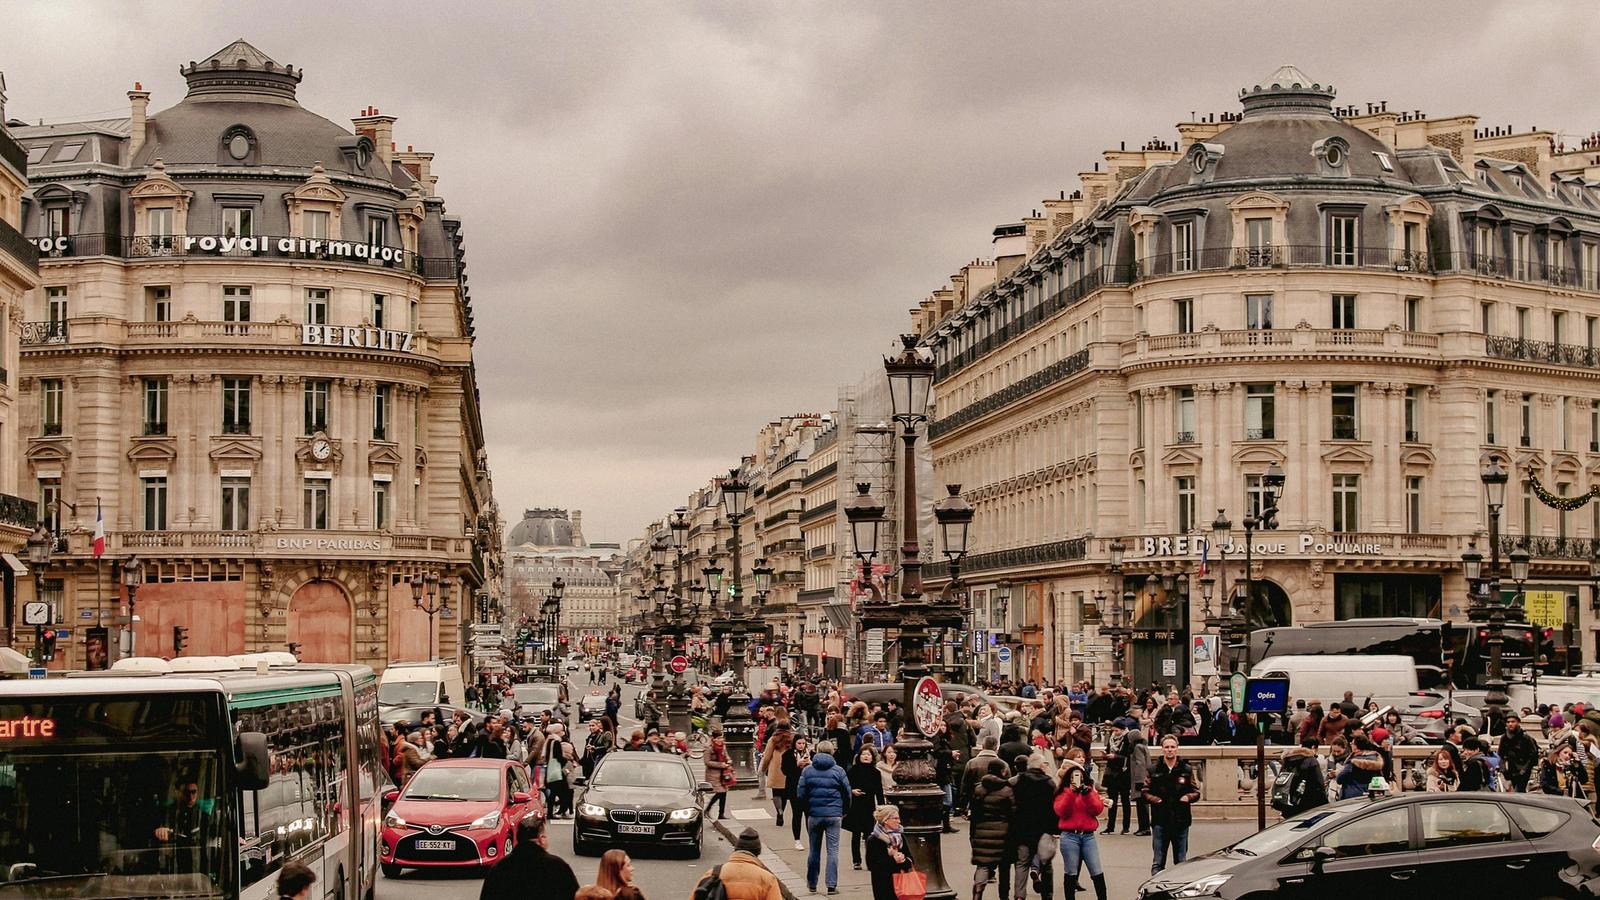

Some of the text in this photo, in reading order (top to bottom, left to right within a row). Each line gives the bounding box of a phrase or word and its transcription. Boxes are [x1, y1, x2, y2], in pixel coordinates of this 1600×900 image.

[184, 236, 403, 263] royal air maroc
[301, 324, 414, 352] BERLITZ
[277, 539, 381, 550] BNP PARIBAS
[1144, 536, 1210, 556] BRED
[1299, 534, 1380, 554] POPULAIRE
[1257, 691, 1276, 700] Opéra
[0, 715, 54, 738] artre
